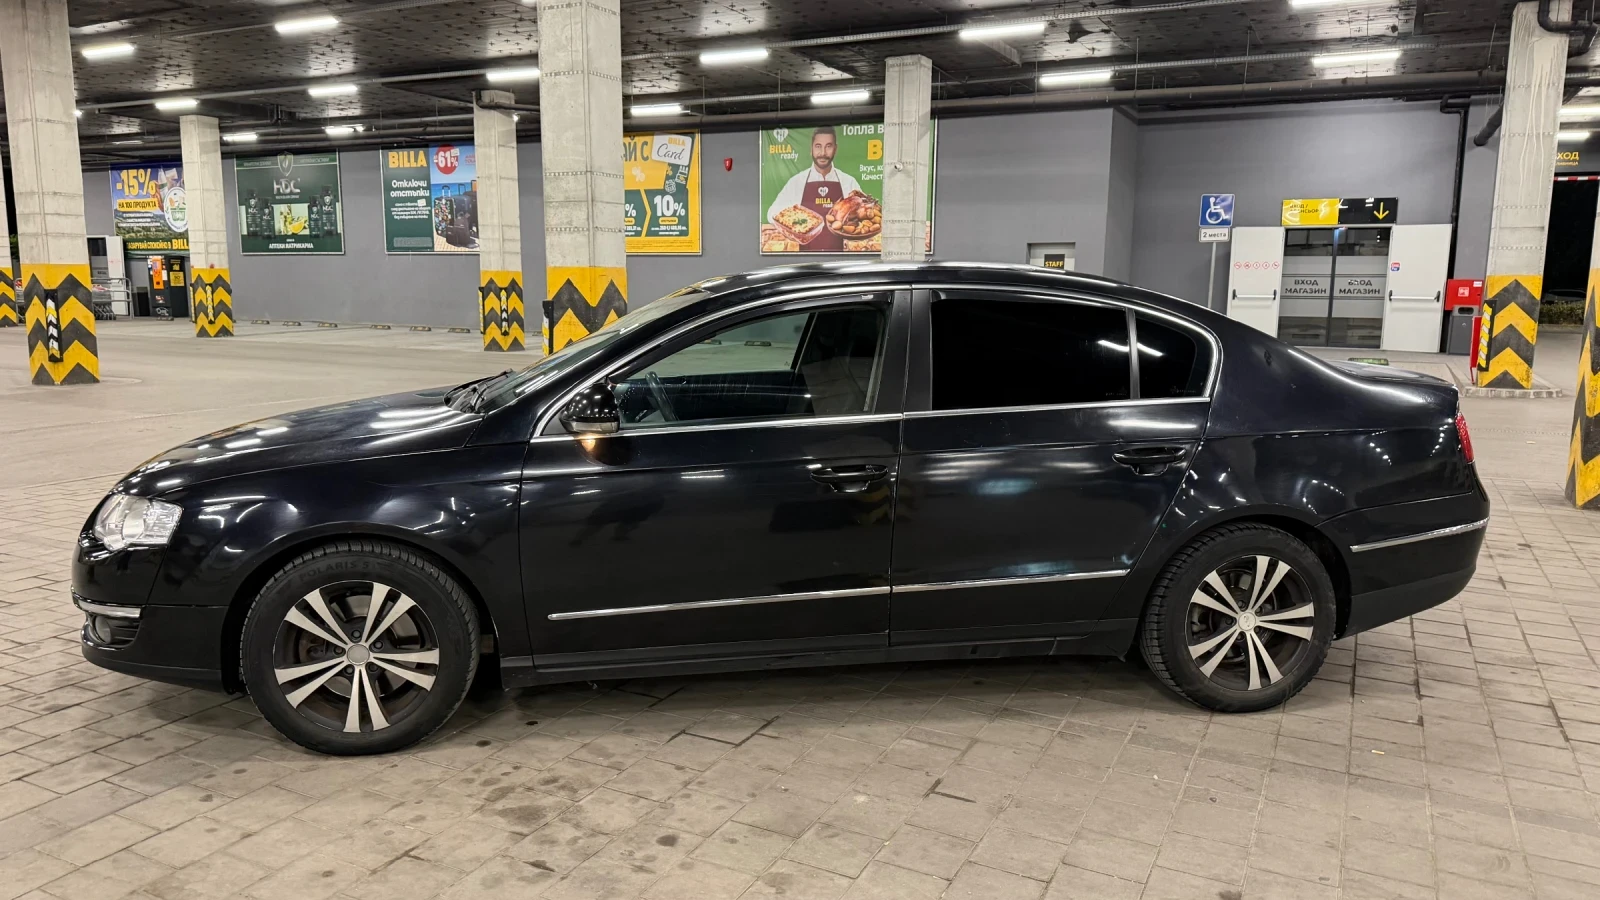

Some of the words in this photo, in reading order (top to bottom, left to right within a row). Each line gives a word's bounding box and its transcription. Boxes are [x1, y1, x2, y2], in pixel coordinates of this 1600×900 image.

[841, 124, 874, 136] Топла
[668, 137, 686, 147] BILLA
[657, 143, 685, 160] Card
[769, 144, 792, 154] BILLA
[388, 150, 427, 168] BILLA
[780, 150, 799, 162] ready
[859, 164, 876, 173] Вкус,
[116, 168, 156, 197] -15%
[391, 178, 428, 188] Отключи
[390, 187, 431, 198] отстъпки
[133, 200, 157, 209] ПРОДУКТА
[653, 194, 686, 217] 10%
[1285, 287, 1327, 295] МАГАЗИН
